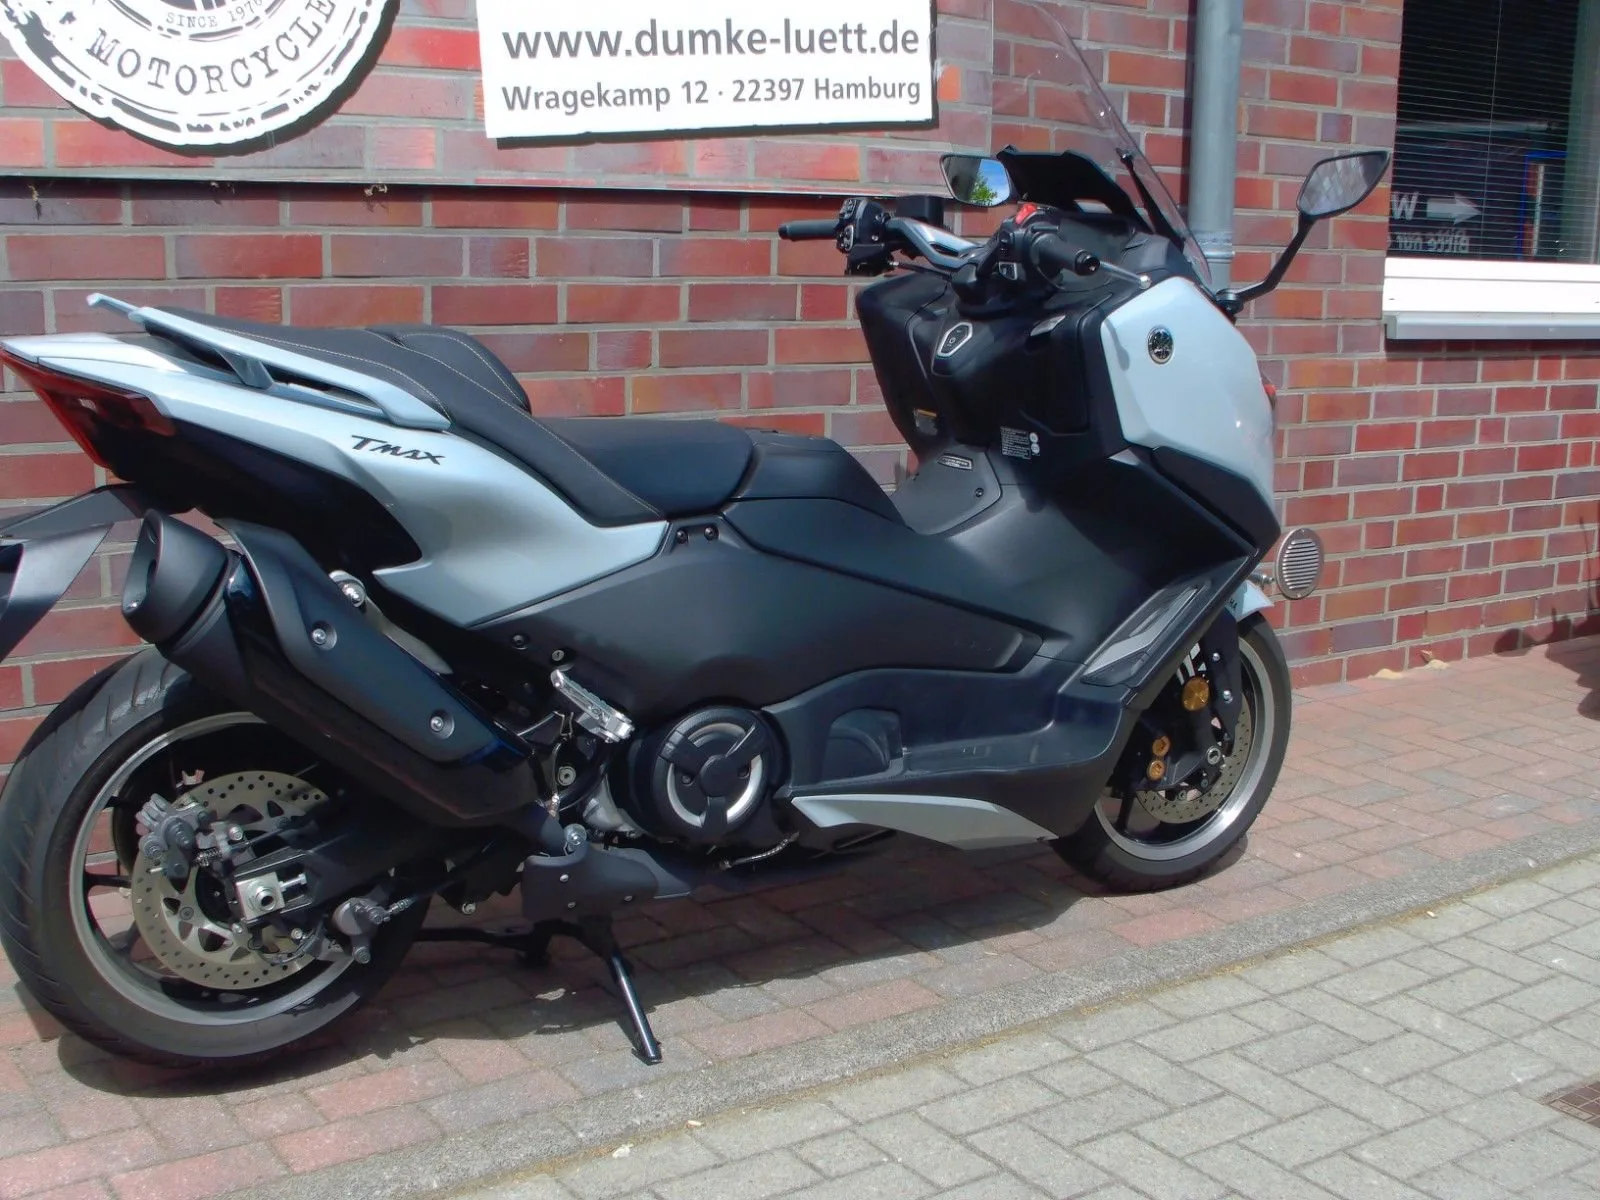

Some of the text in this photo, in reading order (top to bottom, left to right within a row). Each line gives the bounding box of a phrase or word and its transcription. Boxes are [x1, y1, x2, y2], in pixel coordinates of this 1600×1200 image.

[166, 12, 218, 28] SINCE
[501, 17, 919, 60] www.dumke-luett.de
[501, 75, 921, 116] Wragekamp 12 22397 Hamburg
